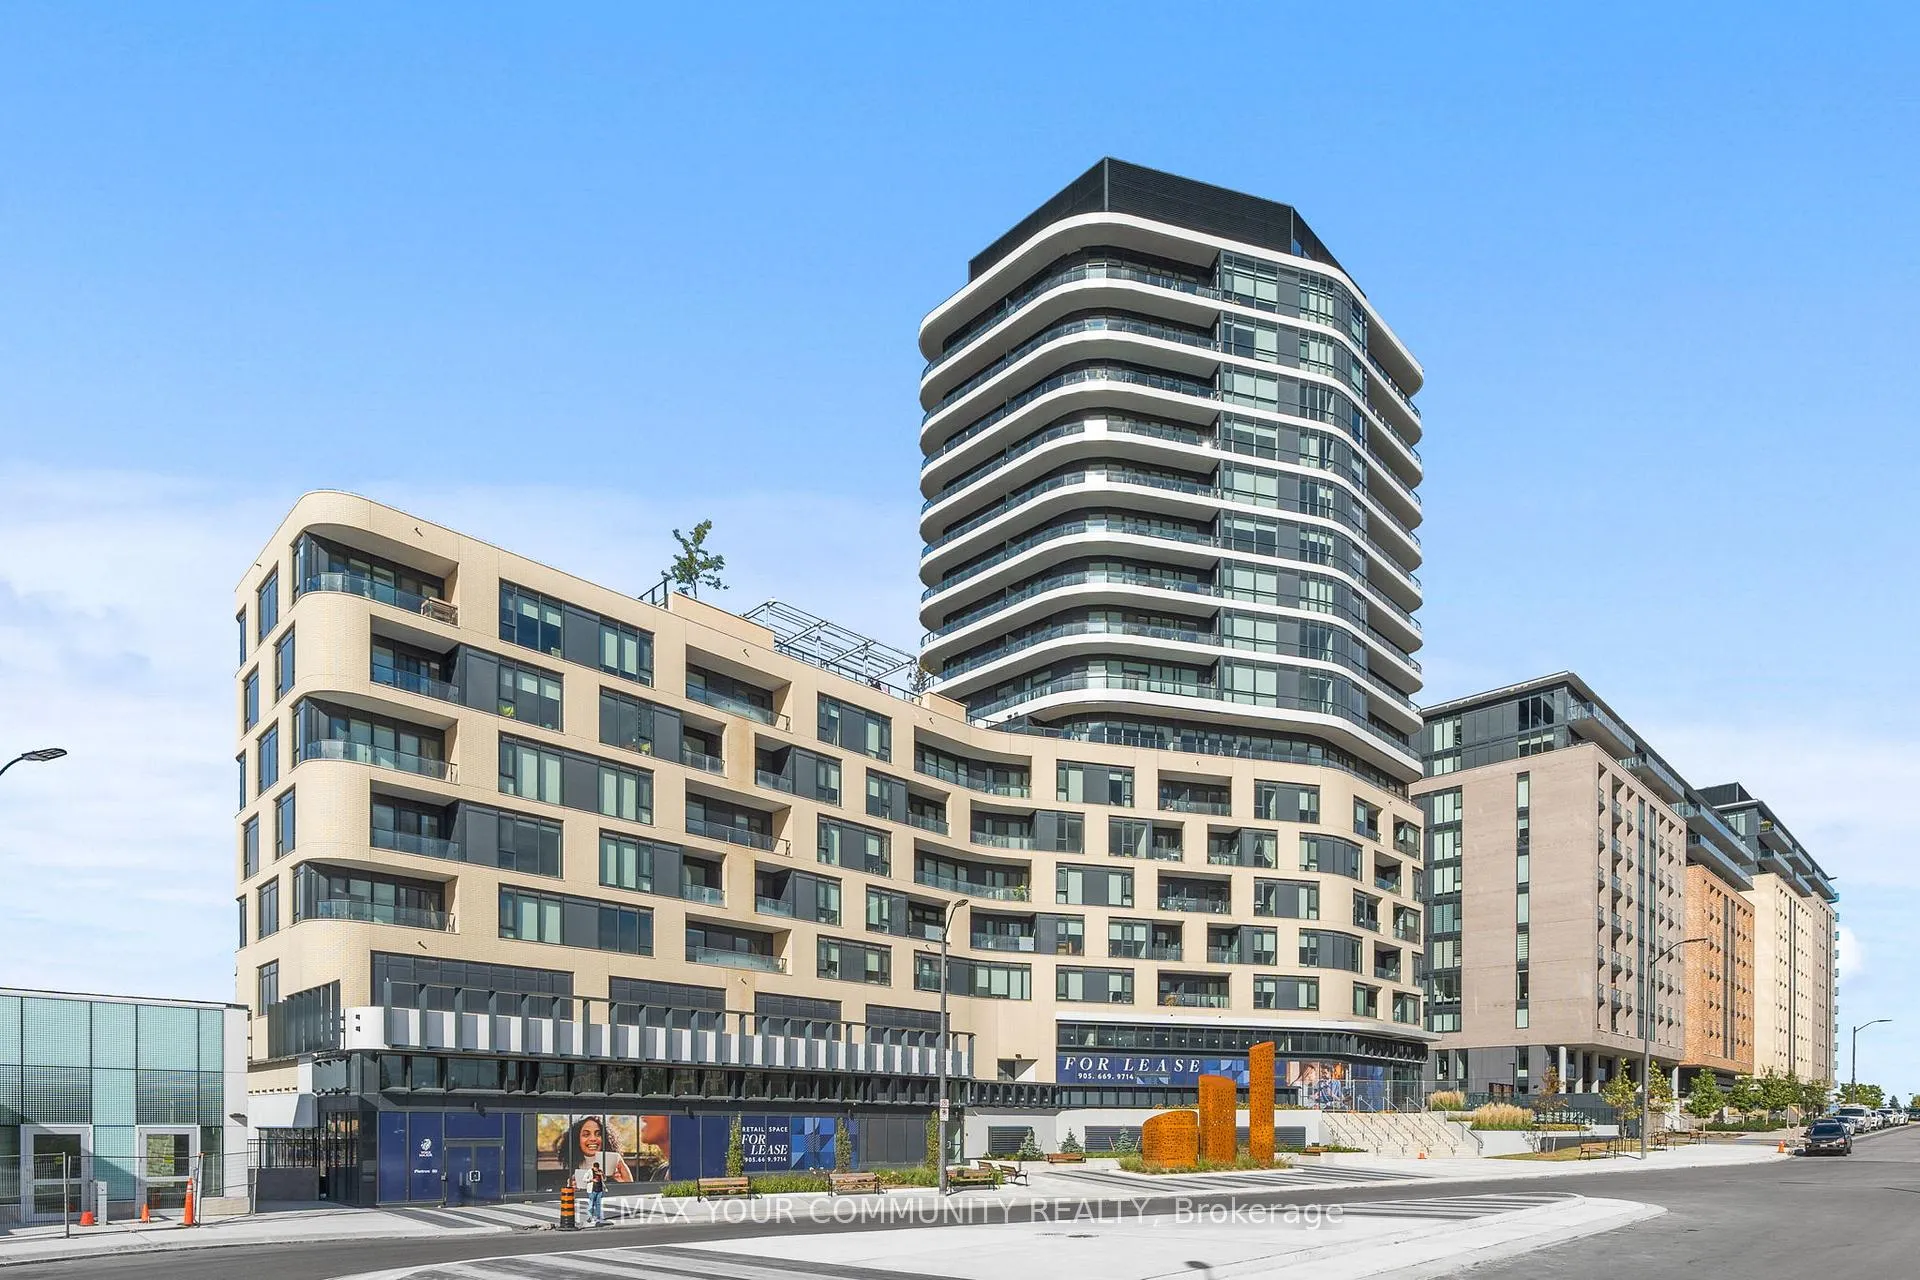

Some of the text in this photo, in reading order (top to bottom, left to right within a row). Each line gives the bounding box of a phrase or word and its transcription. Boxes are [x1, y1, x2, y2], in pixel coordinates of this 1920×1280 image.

[1064, 1056, 1200, 1073] FOR LEASE
[741, 1134, 766, 1145] FOR
[751, 1144, 788, 1155] LEASE
